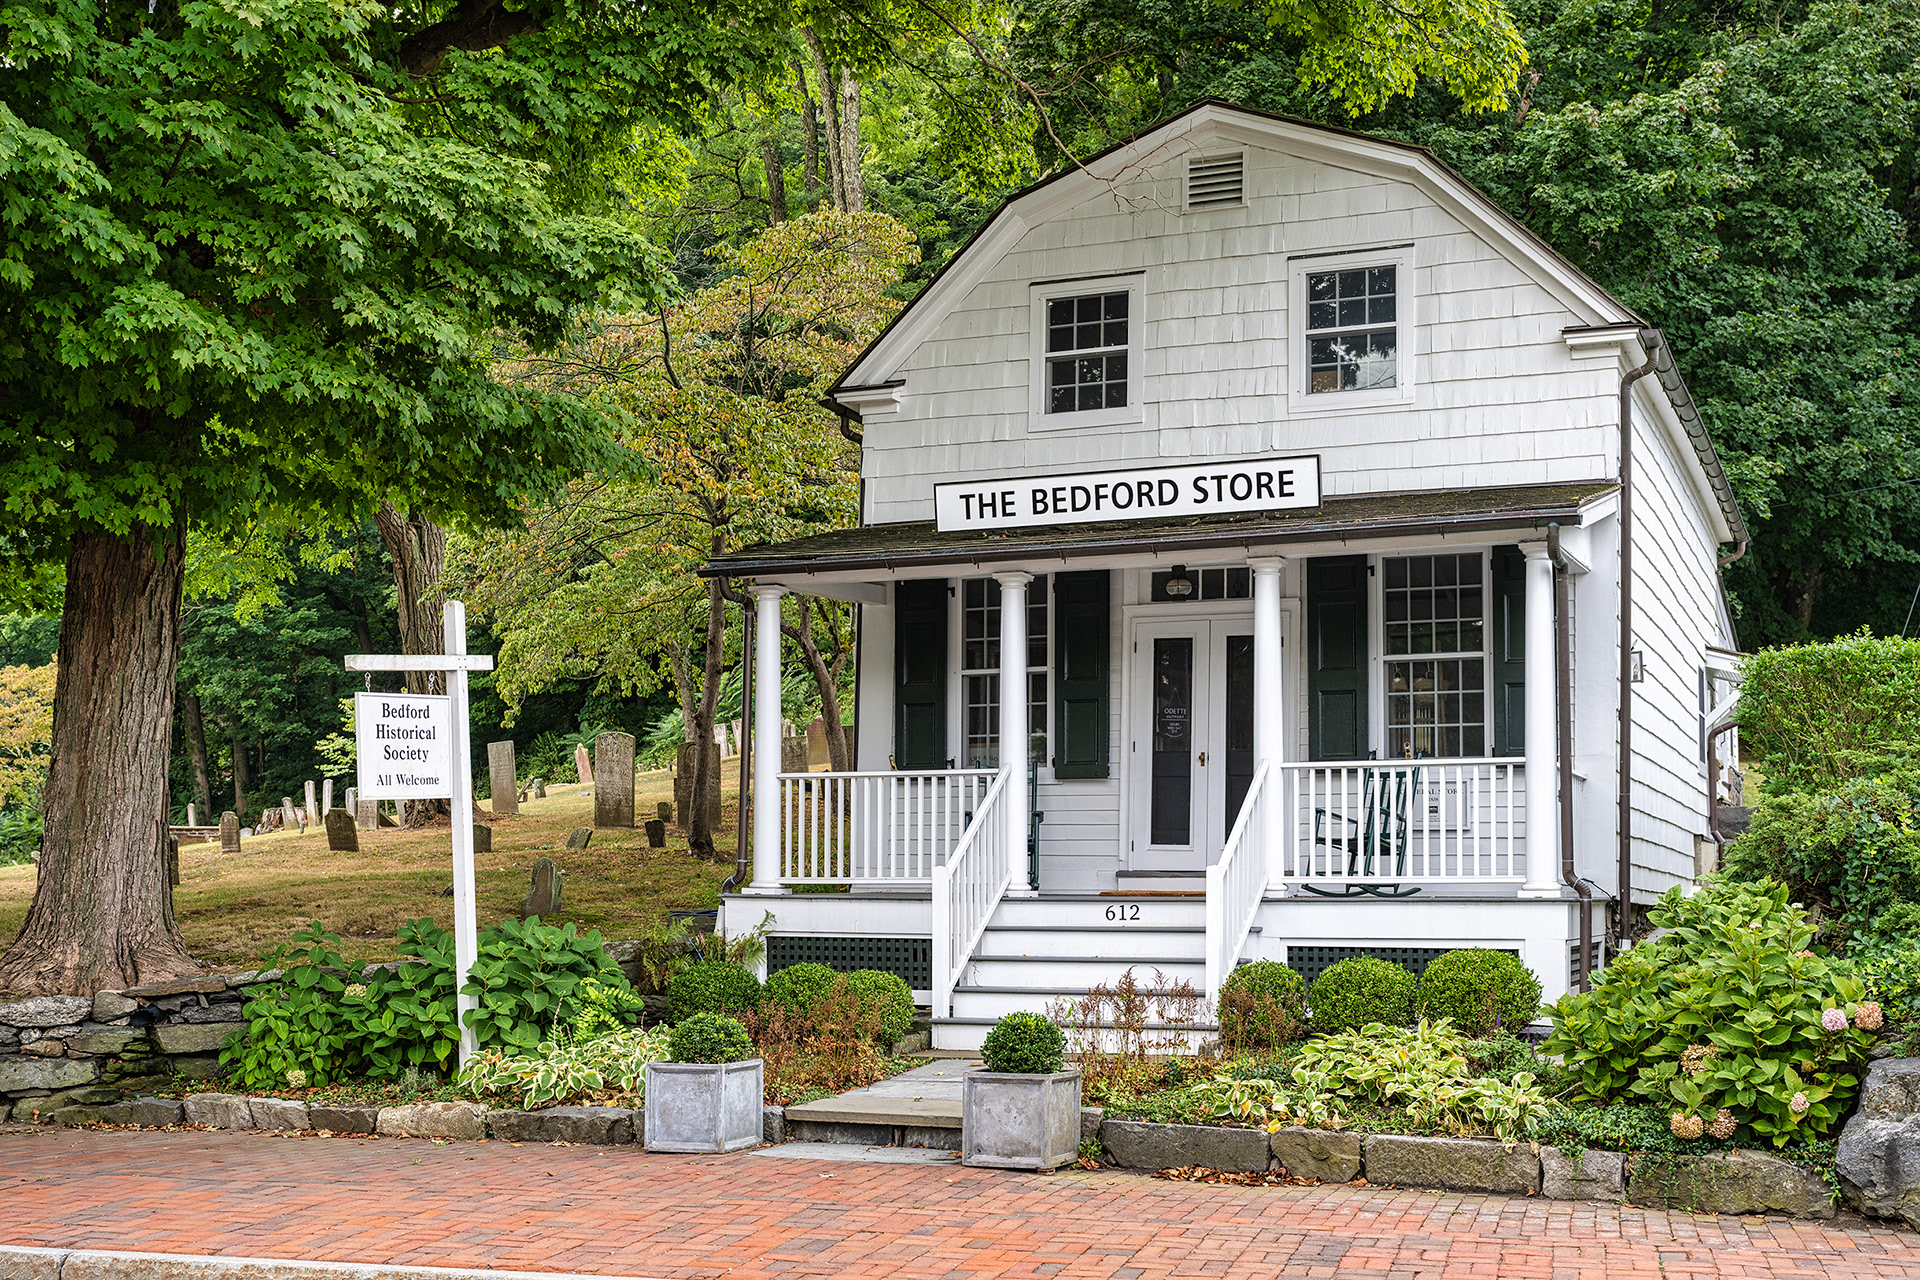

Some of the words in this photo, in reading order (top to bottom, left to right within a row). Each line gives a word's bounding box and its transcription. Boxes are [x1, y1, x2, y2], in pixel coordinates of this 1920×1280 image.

[959, 490, 1016, 520] THE
[1031, 479, 1179, 516] BEDFORD
[1192, 469, 1295, 503] STORE
[381, 702, 430, 719] Bedford
[1163, 707, 1187, 715] ODETTE
[375, 723, 436, 740] Historical
[383, 744, 429, 763] Society
[376, 774, 392, 786] All
[396, 773, 440, 786] Welcome
[1105, 904, 1141, 921] 612
